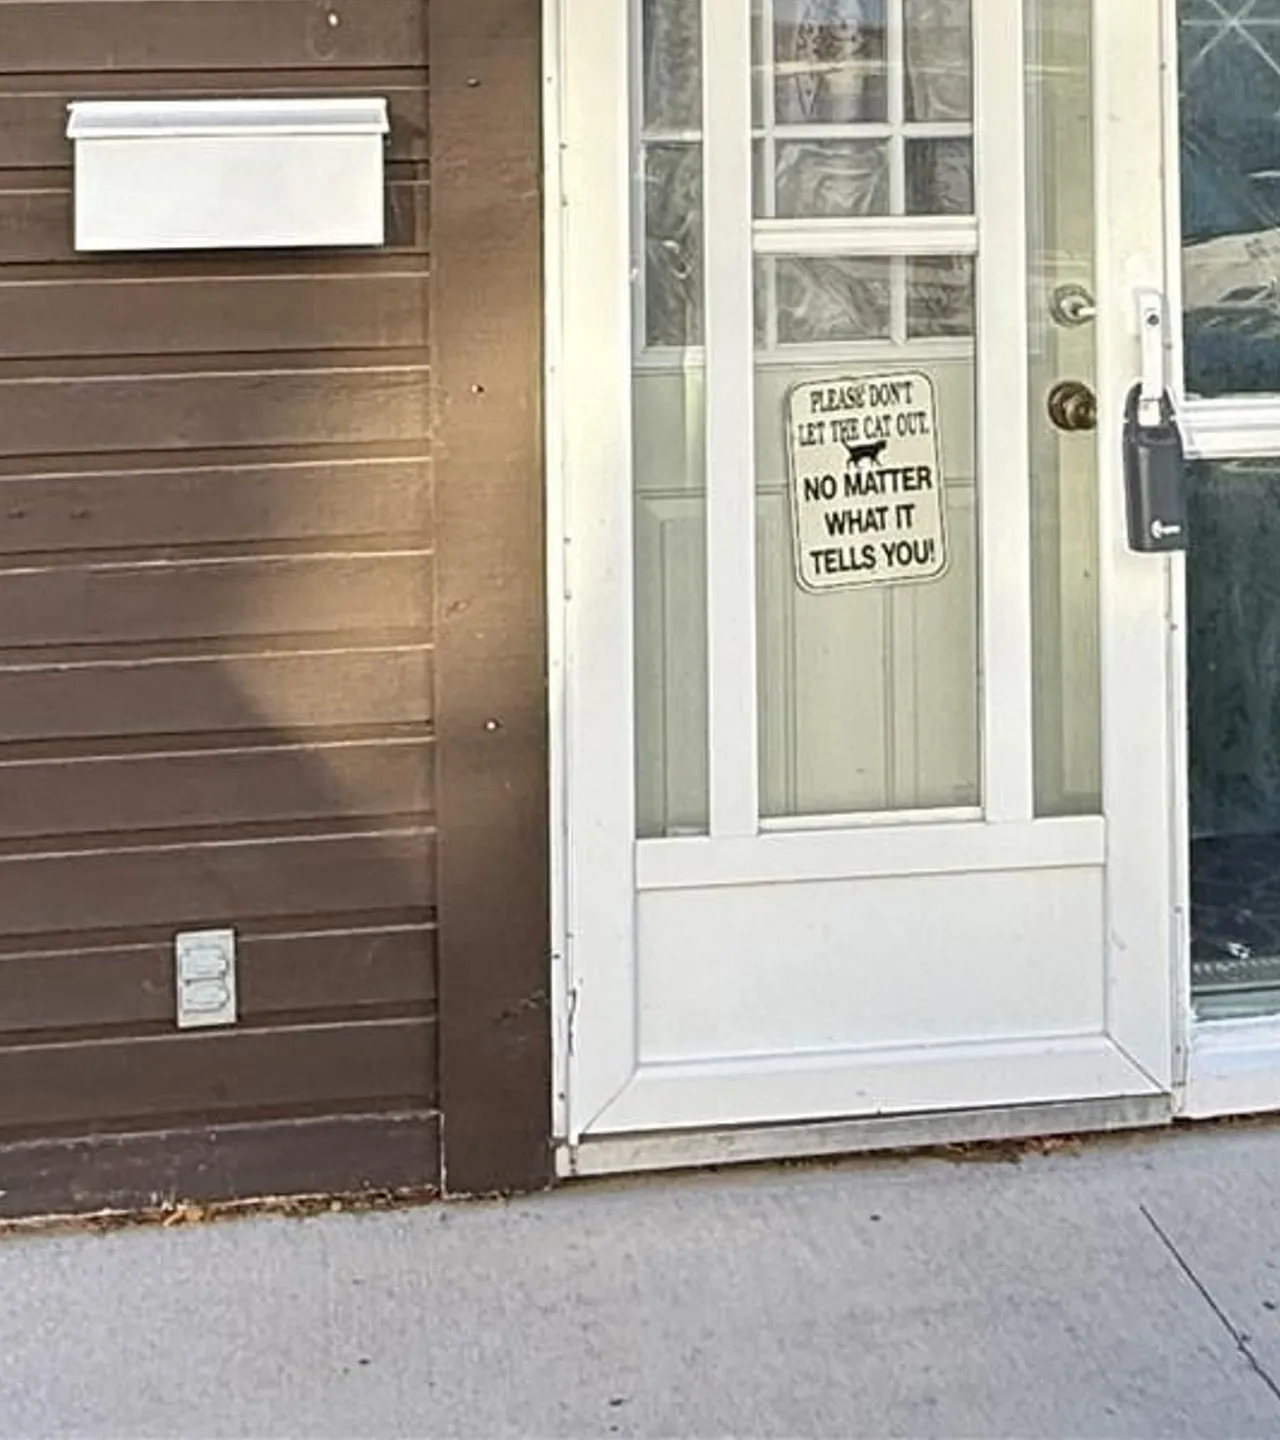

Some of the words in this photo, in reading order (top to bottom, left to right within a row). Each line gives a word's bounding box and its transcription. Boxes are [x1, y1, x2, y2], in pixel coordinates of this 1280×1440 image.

[810, 383, 866, 413] PLEASE
[798, 421, 826, 446] LET
[830, 418, 859, 443] THE
[863, 414, 892, 439] CAT
[896, 411, 929, 437] OUT.
[803, 475, 837, 502] NO
[844, 466, 932, 496] MATTER
[825, 506, 888, 536] WHAT
[895, 503, 916, 529] IT
[809, 545, 877, 575] TELLS
[881, 538, 935, 567] YOU!
